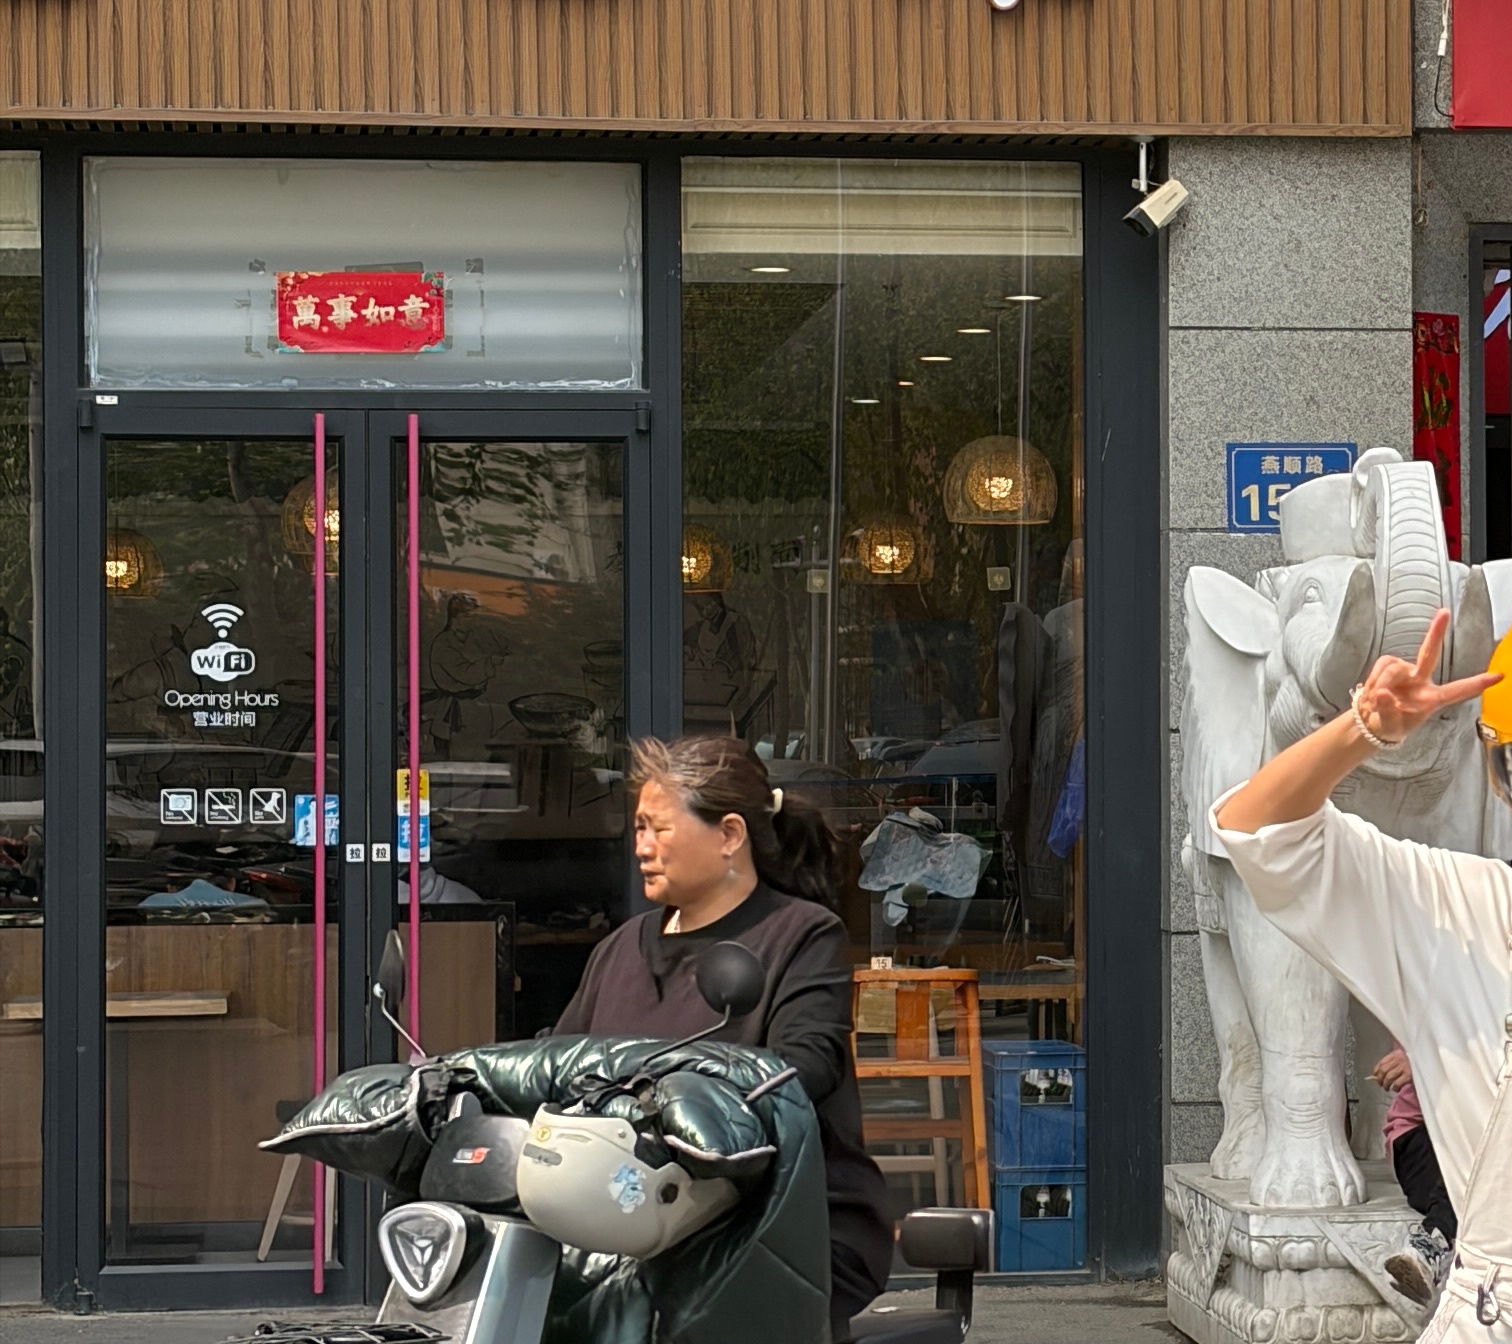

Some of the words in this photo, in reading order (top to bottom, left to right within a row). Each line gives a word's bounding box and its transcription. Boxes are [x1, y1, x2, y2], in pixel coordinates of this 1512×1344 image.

[1260, 455, 1324, 475] 燕顺路
[164, 689, 232, 710] Opening
[234, 689, 280, 707] Hours
[192, 710, 256, 727] 营业时间
[876, 958, 888, 969] 15
